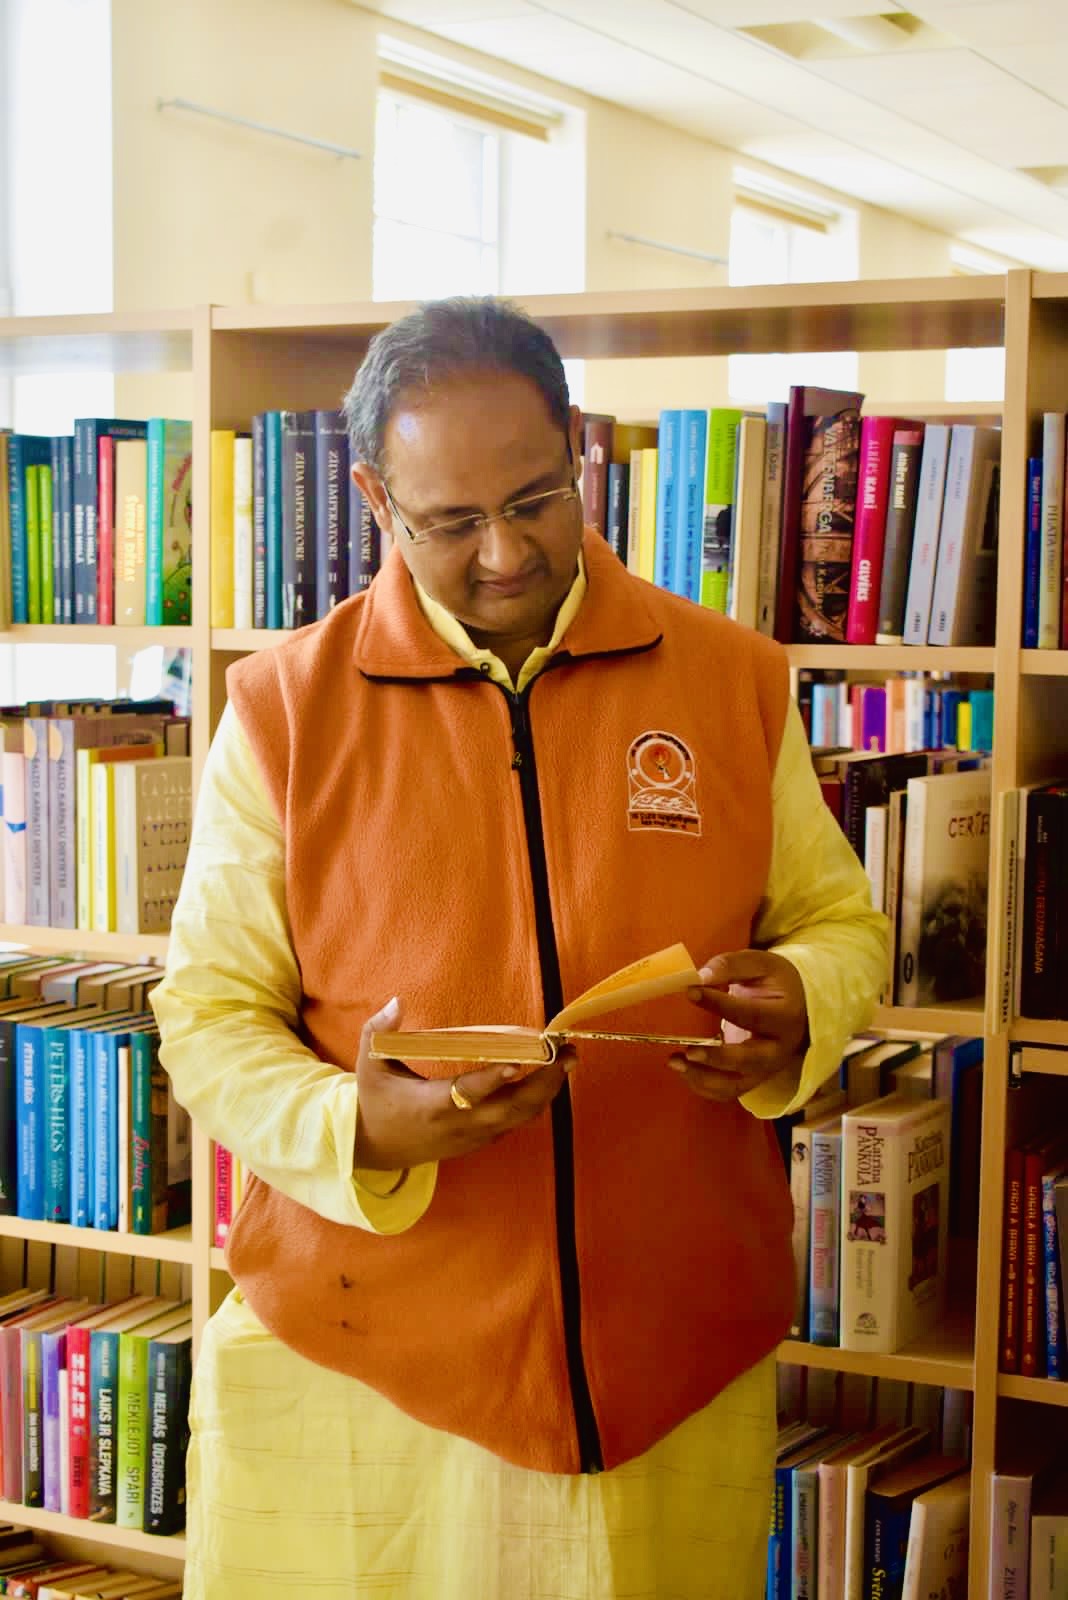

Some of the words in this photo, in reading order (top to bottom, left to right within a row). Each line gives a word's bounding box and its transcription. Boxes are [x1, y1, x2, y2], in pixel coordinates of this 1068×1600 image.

[295, 485, 305, 561] IMPERATORE
[328, 484, 339, 560] IMPERATORE
[857, 1125, 877, 1186] PANKOLA
[98, 1389, 112, 1422] LAIKS
[98, 1424, 111, 1436] IR
[153, 1392, 166, 1437] MELNĀS
[98, 1438, 112, 1496] SLEPKAVA
